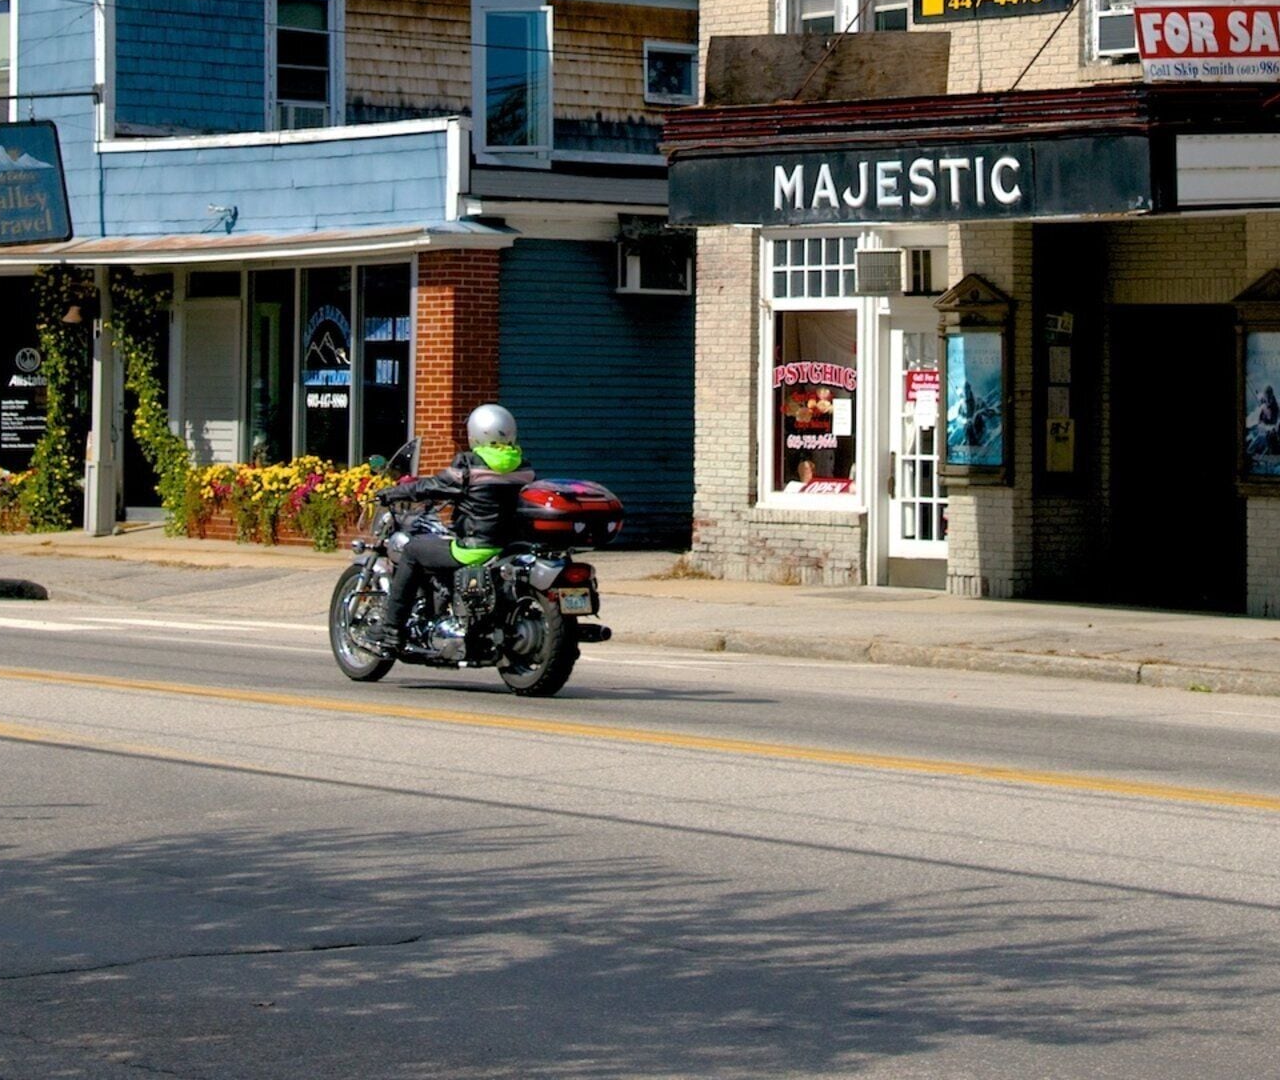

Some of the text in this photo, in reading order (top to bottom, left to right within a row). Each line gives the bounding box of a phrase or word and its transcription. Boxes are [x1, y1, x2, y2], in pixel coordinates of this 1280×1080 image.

[1139, 11, 1218, 54] FOR
[1150, 64, 1170, 77] Call
[1173, 61, 1199, 78] Skip
[1202, 60, 1234, 76] Smith
[773, 156, 1022, 211] MAJESTIC
[773, 361, 857, 391] PSYCHIC
